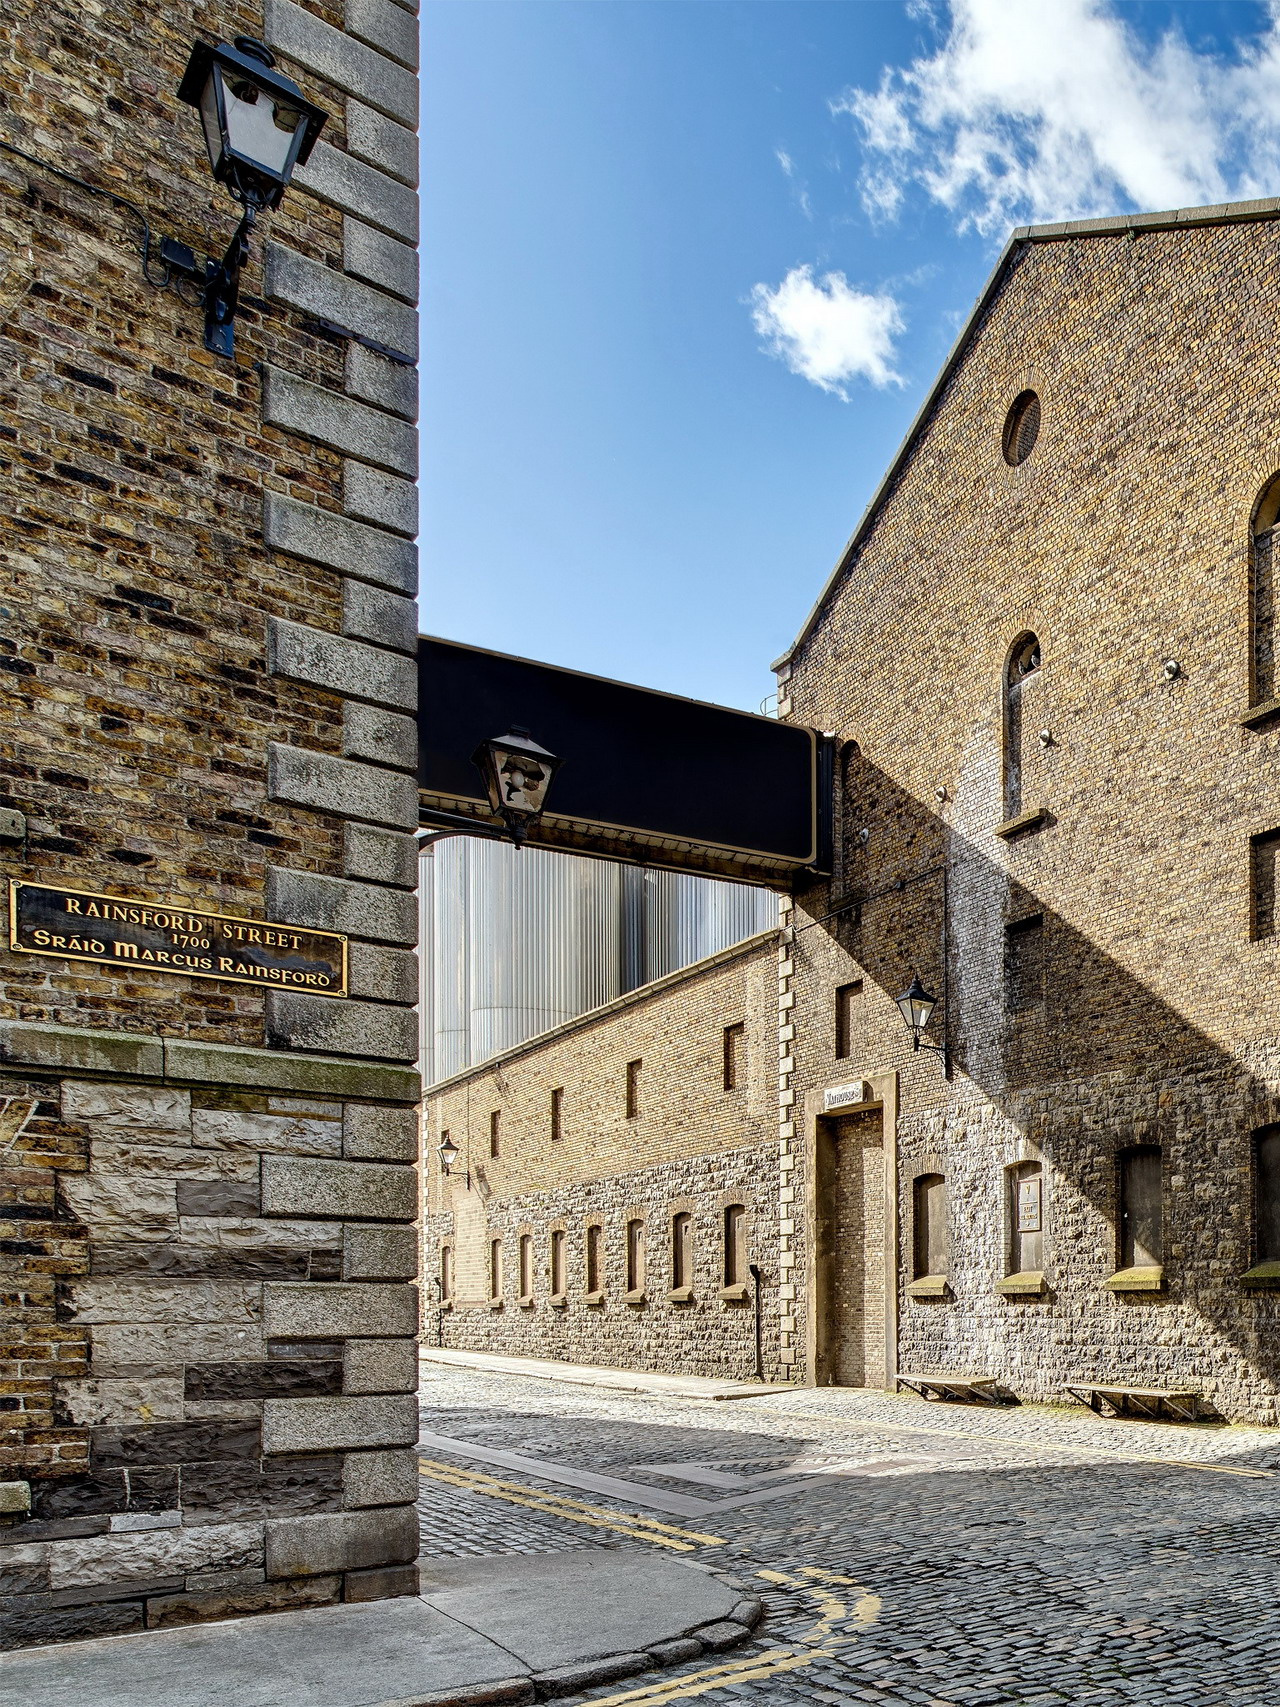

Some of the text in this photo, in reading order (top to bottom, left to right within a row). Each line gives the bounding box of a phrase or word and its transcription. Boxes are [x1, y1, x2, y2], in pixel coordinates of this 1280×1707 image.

[65, 898, 303, 950] RAINSFORD STREET
[172, 933, 210, 950] 1700
